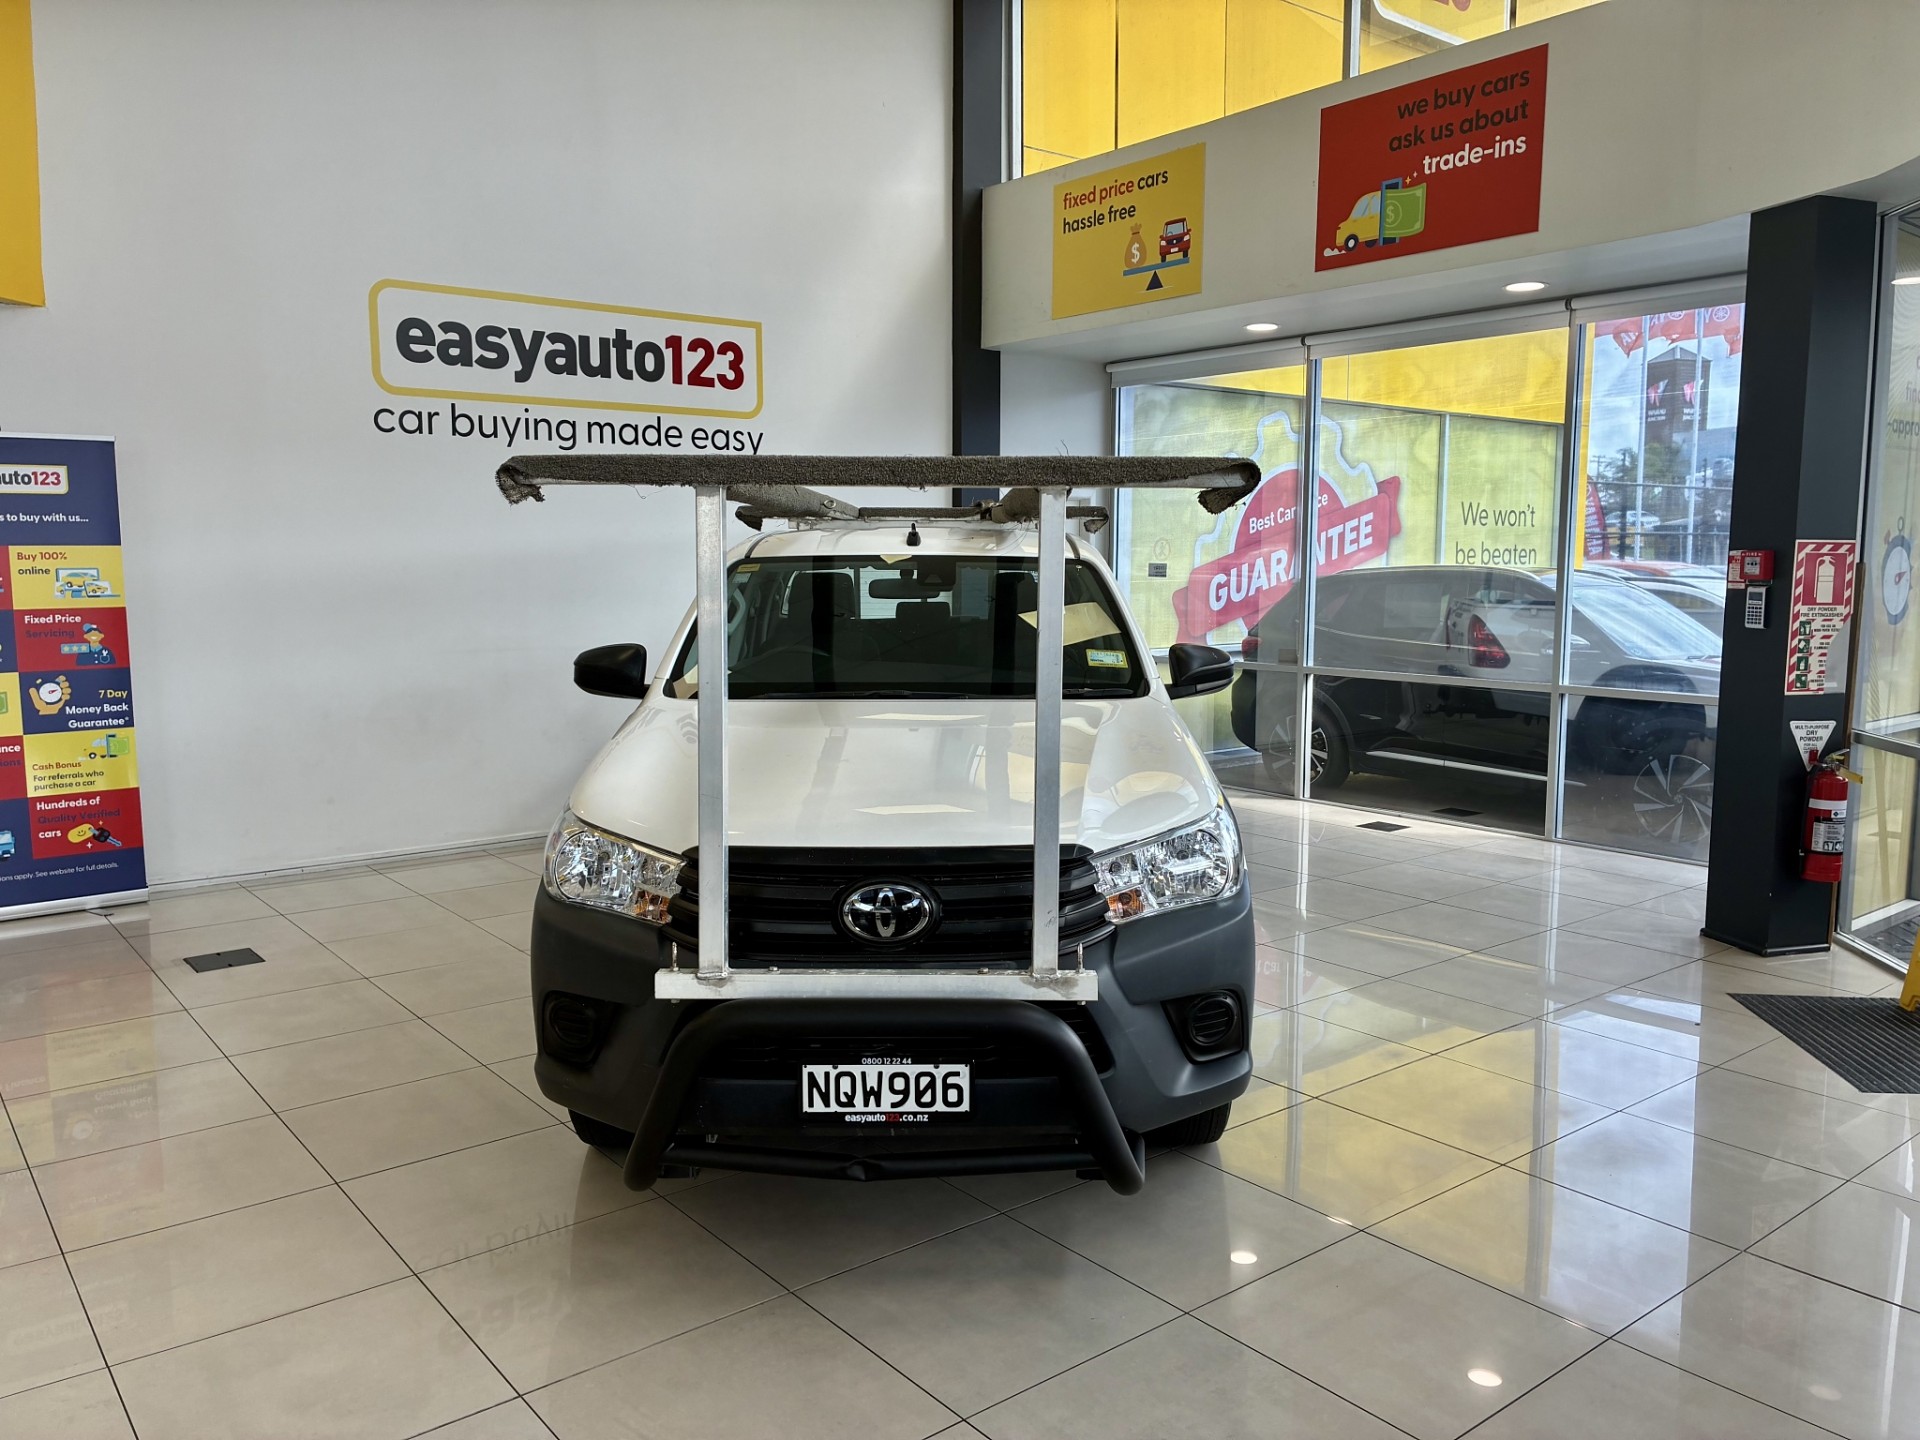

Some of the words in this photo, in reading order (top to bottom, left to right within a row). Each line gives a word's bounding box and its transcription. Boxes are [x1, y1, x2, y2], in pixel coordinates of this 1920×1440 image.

[1397, 95, 1428, 119] we
[1433, 84, 1476, 112] buy
[1480, 69, 1530, 97] cars
[1389, 125, 1425, 152] ask
[1431, 120, 1454, 141] us
[1459, 99, 1529, 134] about
[1423, 135, 1527, 175] trade-ins
[1063, 186, 1096, 210] fixed
[1099, 179, 1135, 205] price
[1137, 170, 1169, 191] cars
[1063, 210, 1105, 234] hassle
[1108, 204, 1137, 223] free
[395, 316, 745, 390] easyauto123
[373, 407, 440, 435] car
[450, 403, 578, 451] buying
[586, 416, 683, 448] made
[690, 427, 765, 456] easy
[0, 470, 61, 486] uto123
[6, 513, 18, 522] to
[19, 513, 40, 524] buy
[42, 513, 66, 522] with
[1249, 512, 1275, 534] Best
[1277, 507, 1296, 523] Car
[1461, 501, 1488, 526] We
[1493, 504, 1536, 527] won't
[17, 552, 37, 562] Buy
[39, 552, 67, 561] 100%
[1456, 541, 1476, 564] be
[1481, 541, 1537, 565] beaten
[18, 567, 51, 575] online
[24, 615, 53, 624] Fixed
[55, 614, 81, 623] Price
[25, 629, 75, 639] Servicing
[99, 690, 105, 698] 7
[107, 689, 128, 700] Day
[66, 705, 102, 715] Money
[104, 703, 129, 712] Back
[32, 762, 54, 771] Cash
[55, 760, 82, 769] Bonus
[33, 774, 46, 782] For
[48, 771, 84, 781] referrals
[85, 769, 105, 778] who
[34, 780, 73, 792] purchase
[82, 779, 96, 787] car
[36, 798, 87, 811] Hundreds
[89, 796, 101, 806] of
[38, 813, 77, 825] Quality
[79, 808, 121, 821] Verified
[38, 829, 62, 839] cars
[49, 868, 75, 876] website
[861, 1057, 882, 1065] 0800
[883, 1057, 891, 1065] 12
[892, 1057, 901, 1065] 22
[902, 1057, 912, 1065] 44
[807, 1071, 964, 1109] NQW906
[845, 1113, 929, 1123] easyauto123.co.nz
